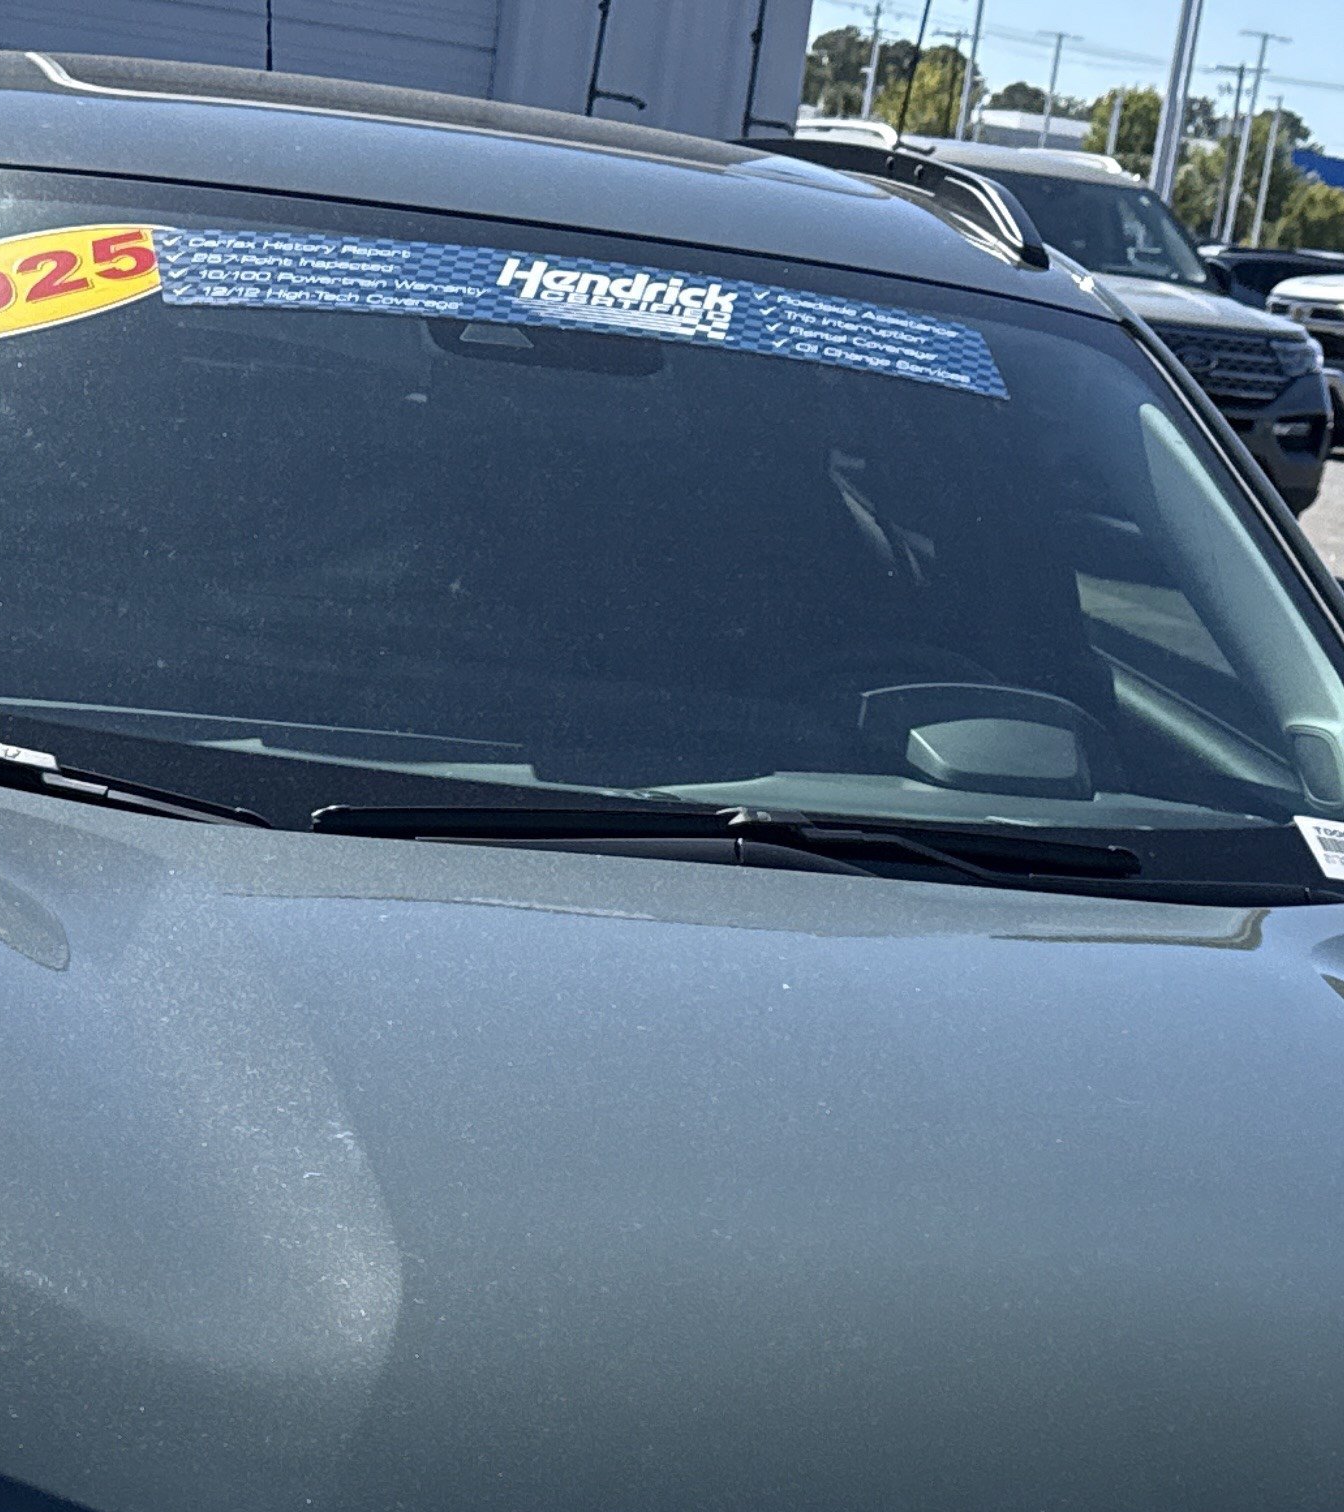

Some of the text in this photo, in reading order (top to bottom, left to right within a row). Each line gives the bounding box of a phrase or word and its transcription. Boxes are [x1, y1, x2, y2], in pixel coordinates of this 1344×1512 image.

[188, 237, 412, 259] Carfax History Report
[199, 269, 272, 281] 10/100
[276, 271, 388, 289] Powertrain
[496, 257, 739, 315] Hendrick
[202, 285, 260, 298] 12/12
[266, 287, 360, 302] High-Tech
[540, 290, 732, 323] CERTIFIED
[777, 295, 960, 338] Roadside Assistance
[784, 309, 817, 324] Trip
[789, 325, 847, 344] Rental
[795, 342, 971, 384] Oil Change Services
